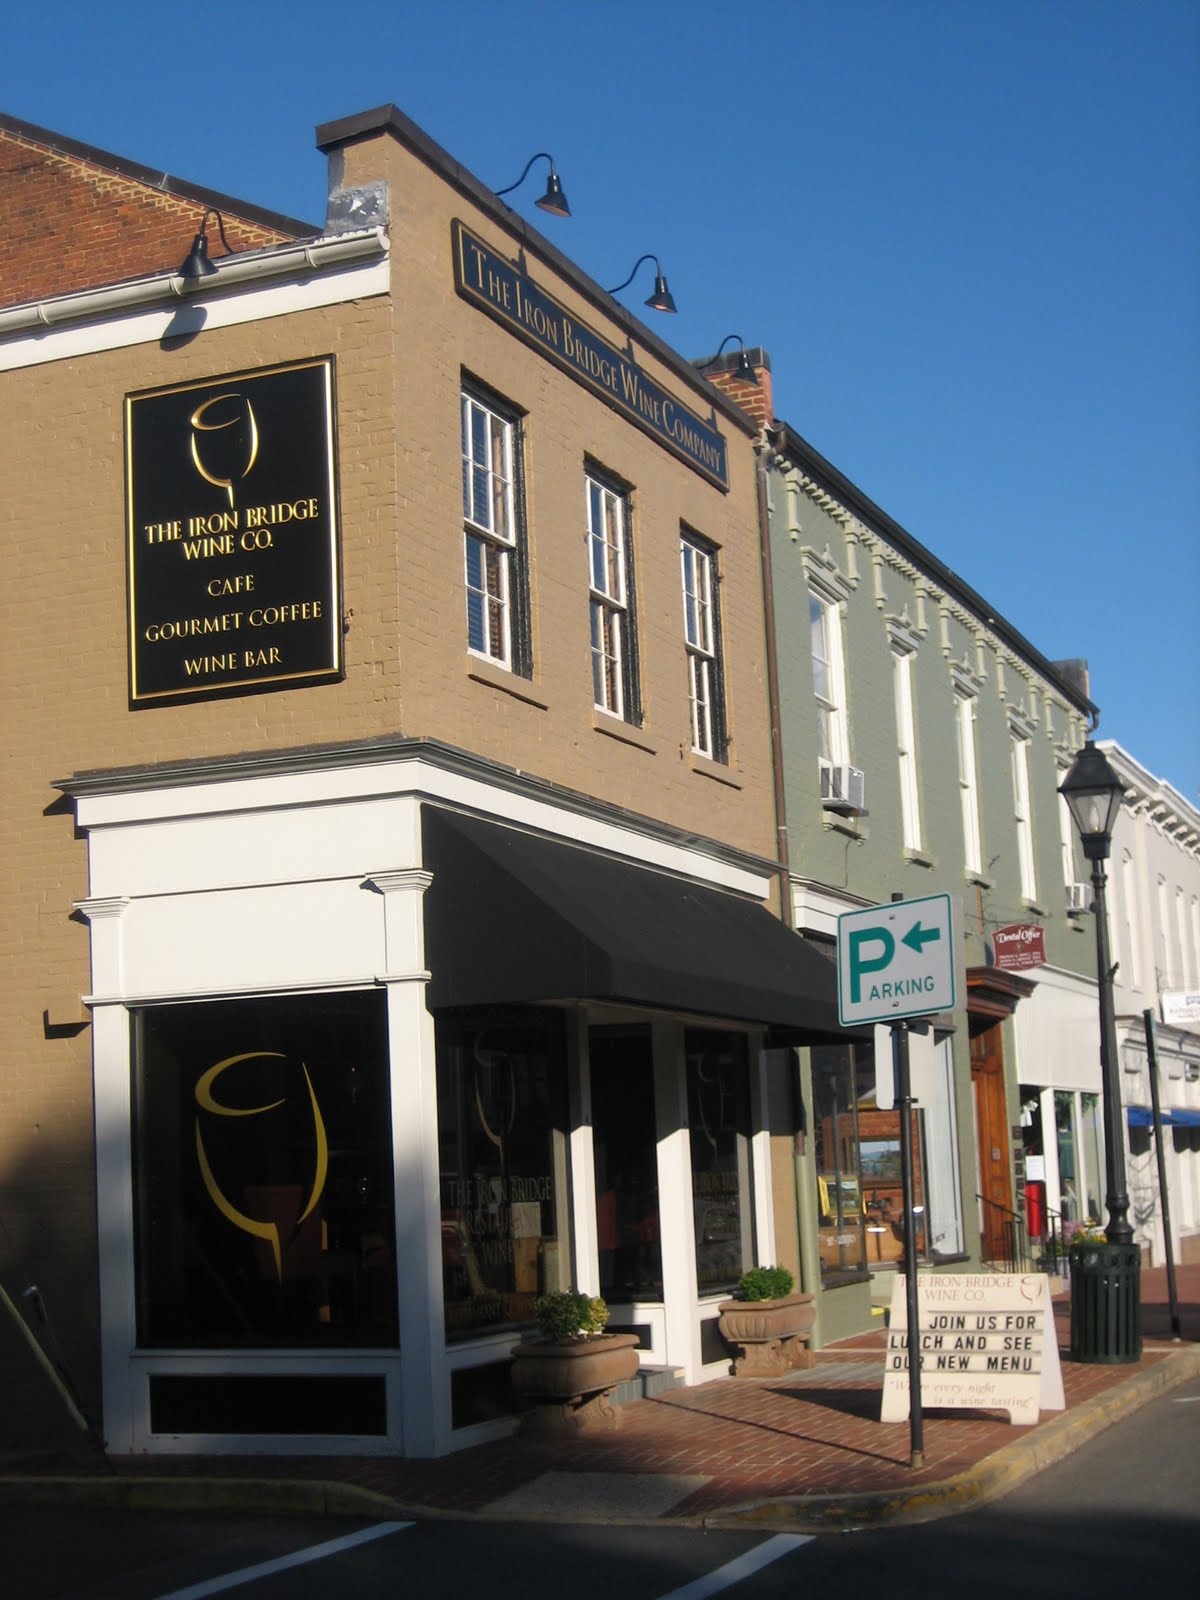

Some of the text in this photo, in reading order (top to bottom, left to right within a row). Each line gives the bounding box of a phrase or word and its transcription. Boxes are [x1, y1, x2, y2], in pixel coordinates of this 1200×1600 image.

[471, 244, 721, 473] THE IRON BRIDGE WINE COMPANY
[144, 498, 319, 544] THE IRON BRIDGE
[182, 529, 274, 560] WINE CO.
[207, 574, 255, 597] CAFE
[145, 601, 322, 642] GOURMET COFFEE
[184, 647, 282, 676] WINE BAR
[997, 929, 1021, 944] Dental
[900, 1276, 1015, 1288] TE IRON BRIDGE
[924, 1289, 960, 1301] WINE
[929, 1315, 1036, 1330] JOIN US FOR
[890, 1335, 1032, 1350] LUCH AND SEE
[937, 1355, 970, 1370] NEW
[987, 1356, 1032, 1371] MENU
